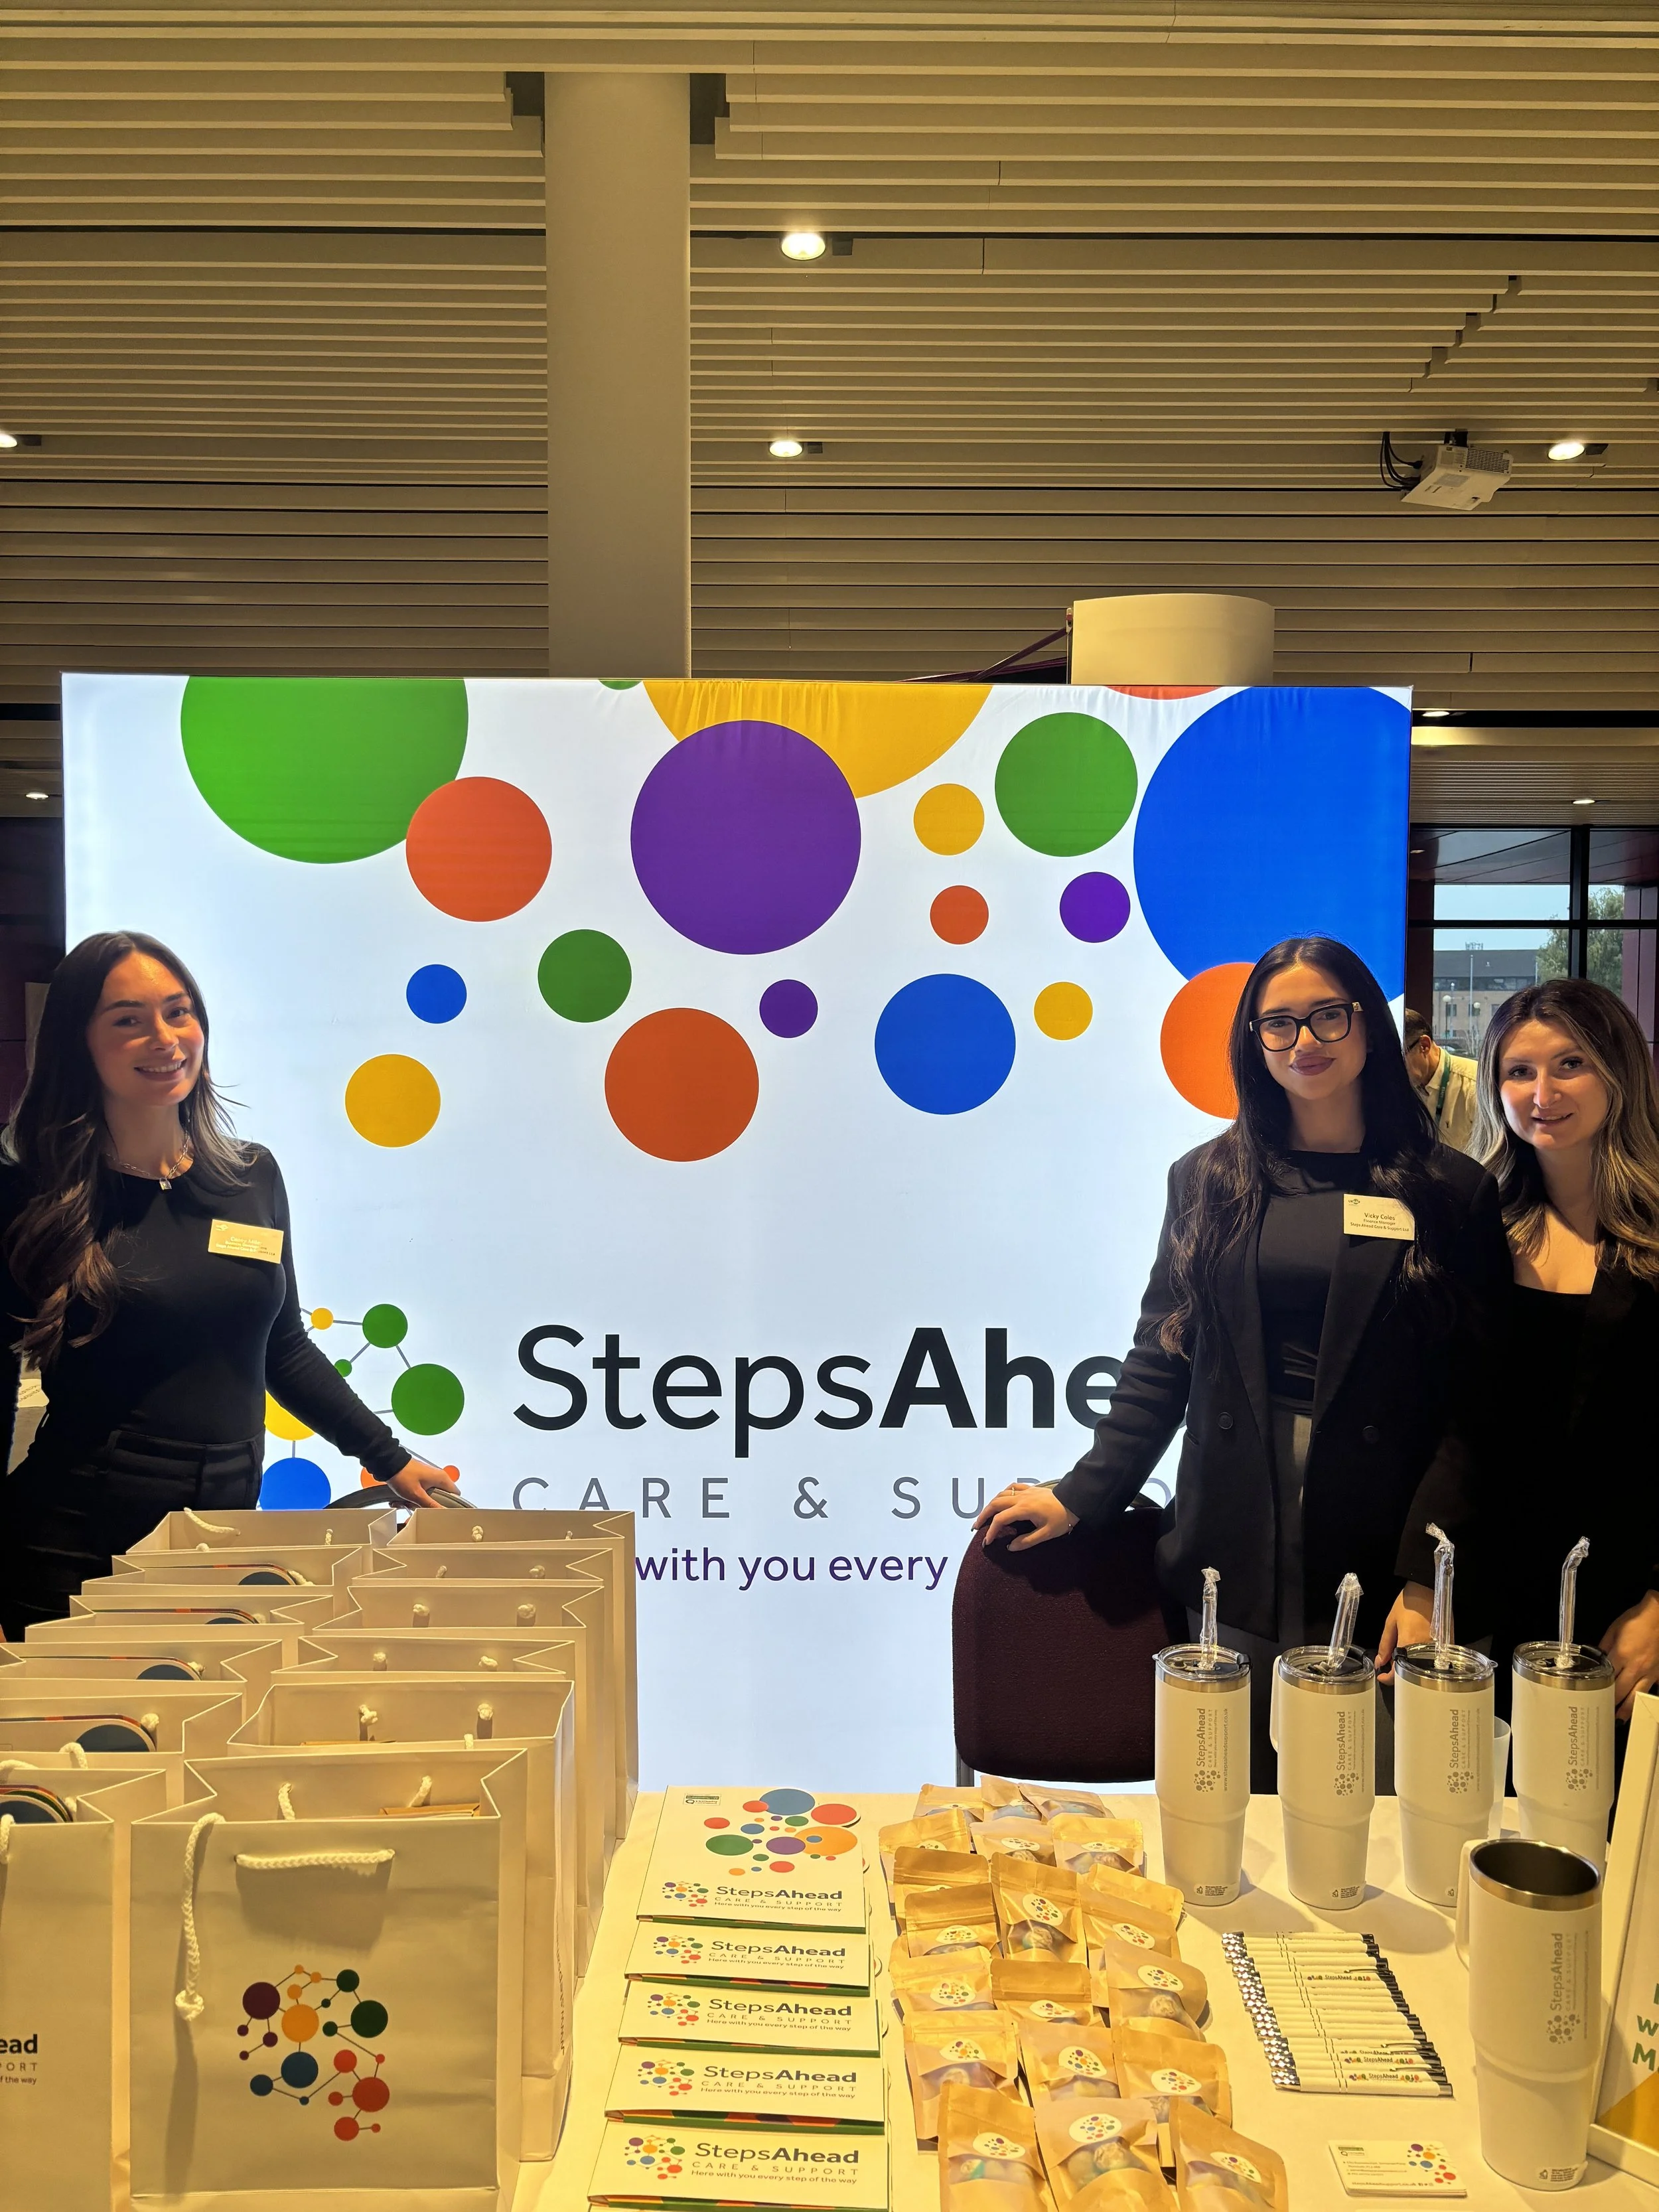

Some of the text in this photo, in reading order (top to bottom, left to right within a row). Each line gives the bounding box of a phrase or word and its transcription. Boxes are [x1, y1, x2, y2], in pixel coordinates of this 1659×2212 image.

[513, 1323, 1123, 1458] StepsAhe
[513, 1477, 828, 1519] CARE &
[635, 1547, 948, 1591] with you every
[1196, 1708, 1207, 1767] StepsAhead
[1336, 1712, 1347, 1771] StepsAhead
[1449, 1709, 1460, 1768] StepsAhead
[1568, 1706, 1579, 1765] StepsAhead
[717, 1886, 842, 1899] StepsAhead
[711, 1941, 845, 1956] StepsAhead
[1550, 1933, 1564, 2011] StepsAhead
[709, 1999, 851, 2016] StepsAhead
[0, 2062, 37, 2071] ORT
[703, 2065, 856, 2083] StepsAhead
[695, 2142, 859, 2164] StepsAhead
[772, 2166, 858, 2175] SUPPORT
